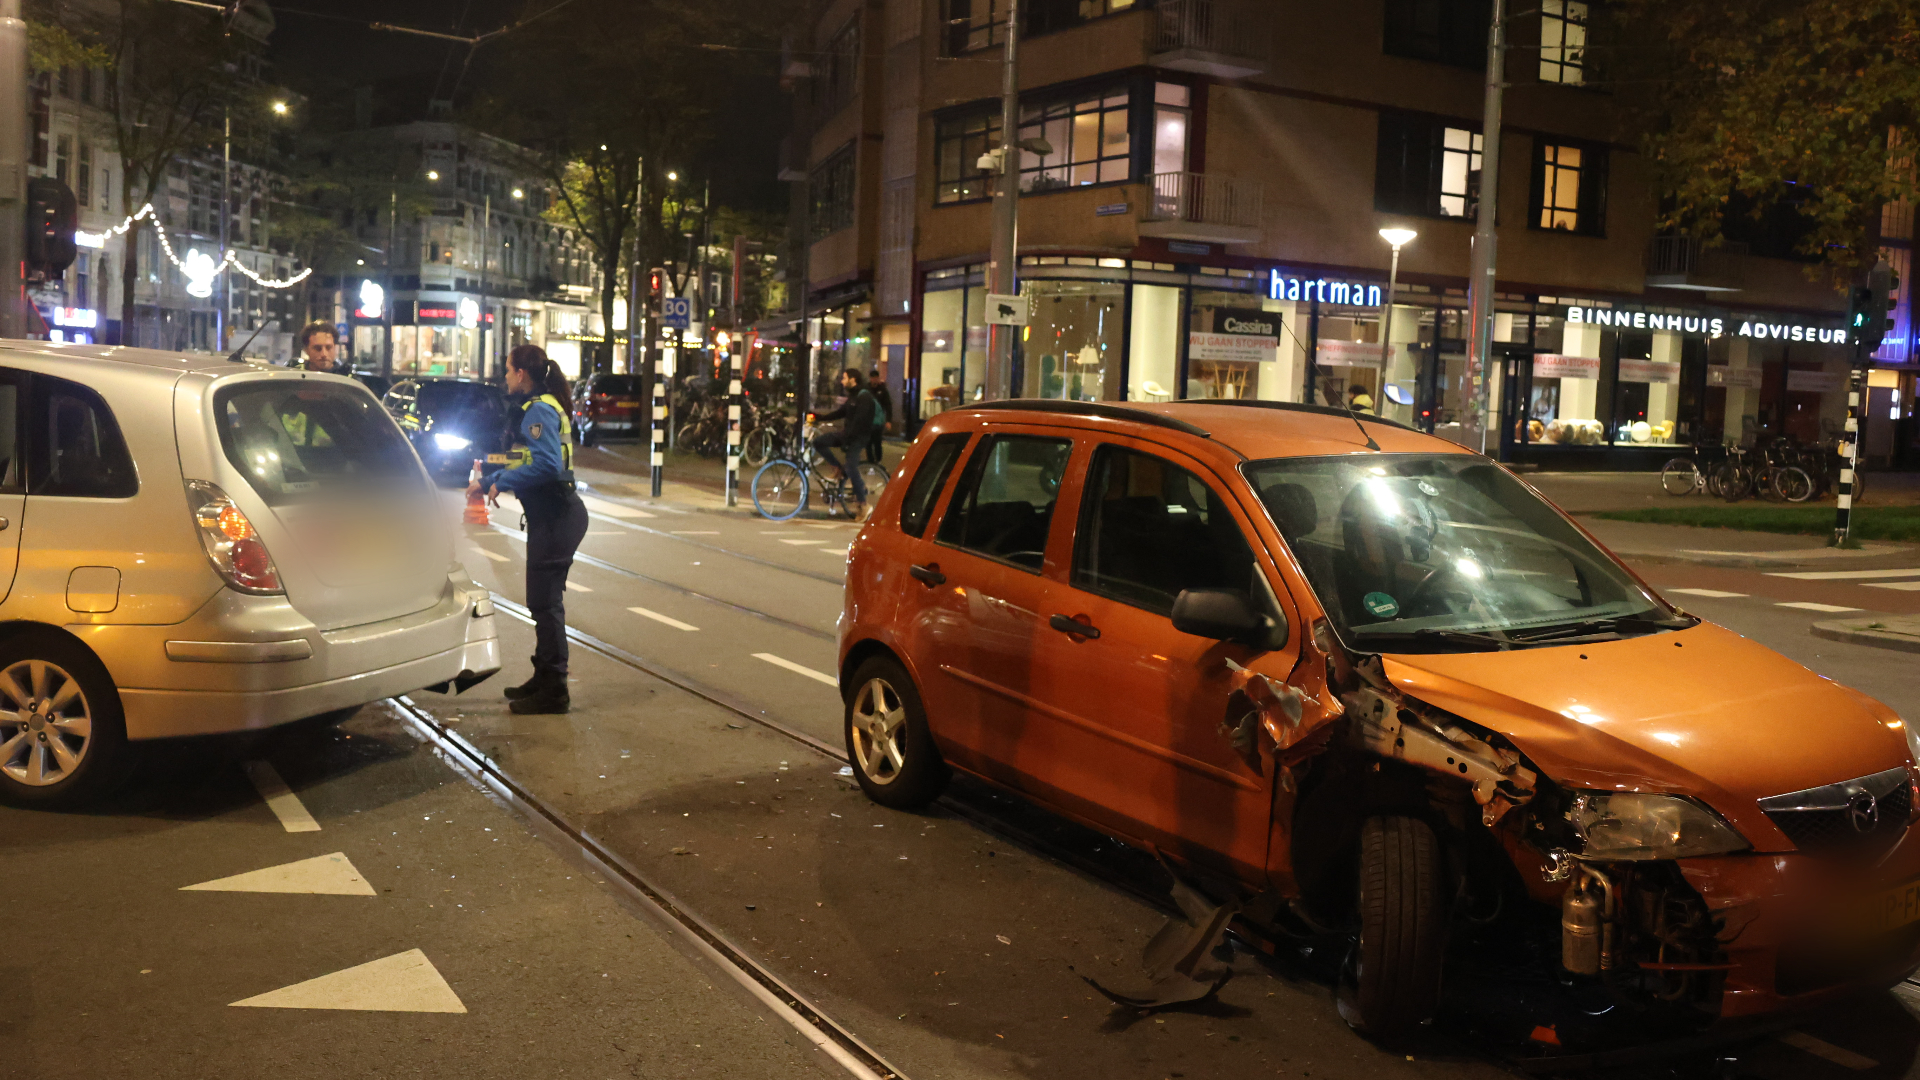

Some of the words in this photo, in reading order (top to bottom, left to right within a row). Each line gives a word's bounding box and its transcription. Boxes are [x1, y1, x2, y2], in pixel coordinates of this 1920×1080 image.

[1270, 268, 1381, 307] hartman
[665, 300, 687, 316] 30
[1224, 317, 1273, 335] Cassina
[1567, 306, 1723, 334] BINNENHUIS
[1738, 321, 1847, 345] ADVISEUR
[1189, 335, 1205, 346] WIJ
[1207, 336, 1233, 348] GAAN
[1235, 338, 1278, 350] STOPPEN
[1547, 356, 1568, 367] GAAN
[1569, 357, 1600, 369] STOPPEN
